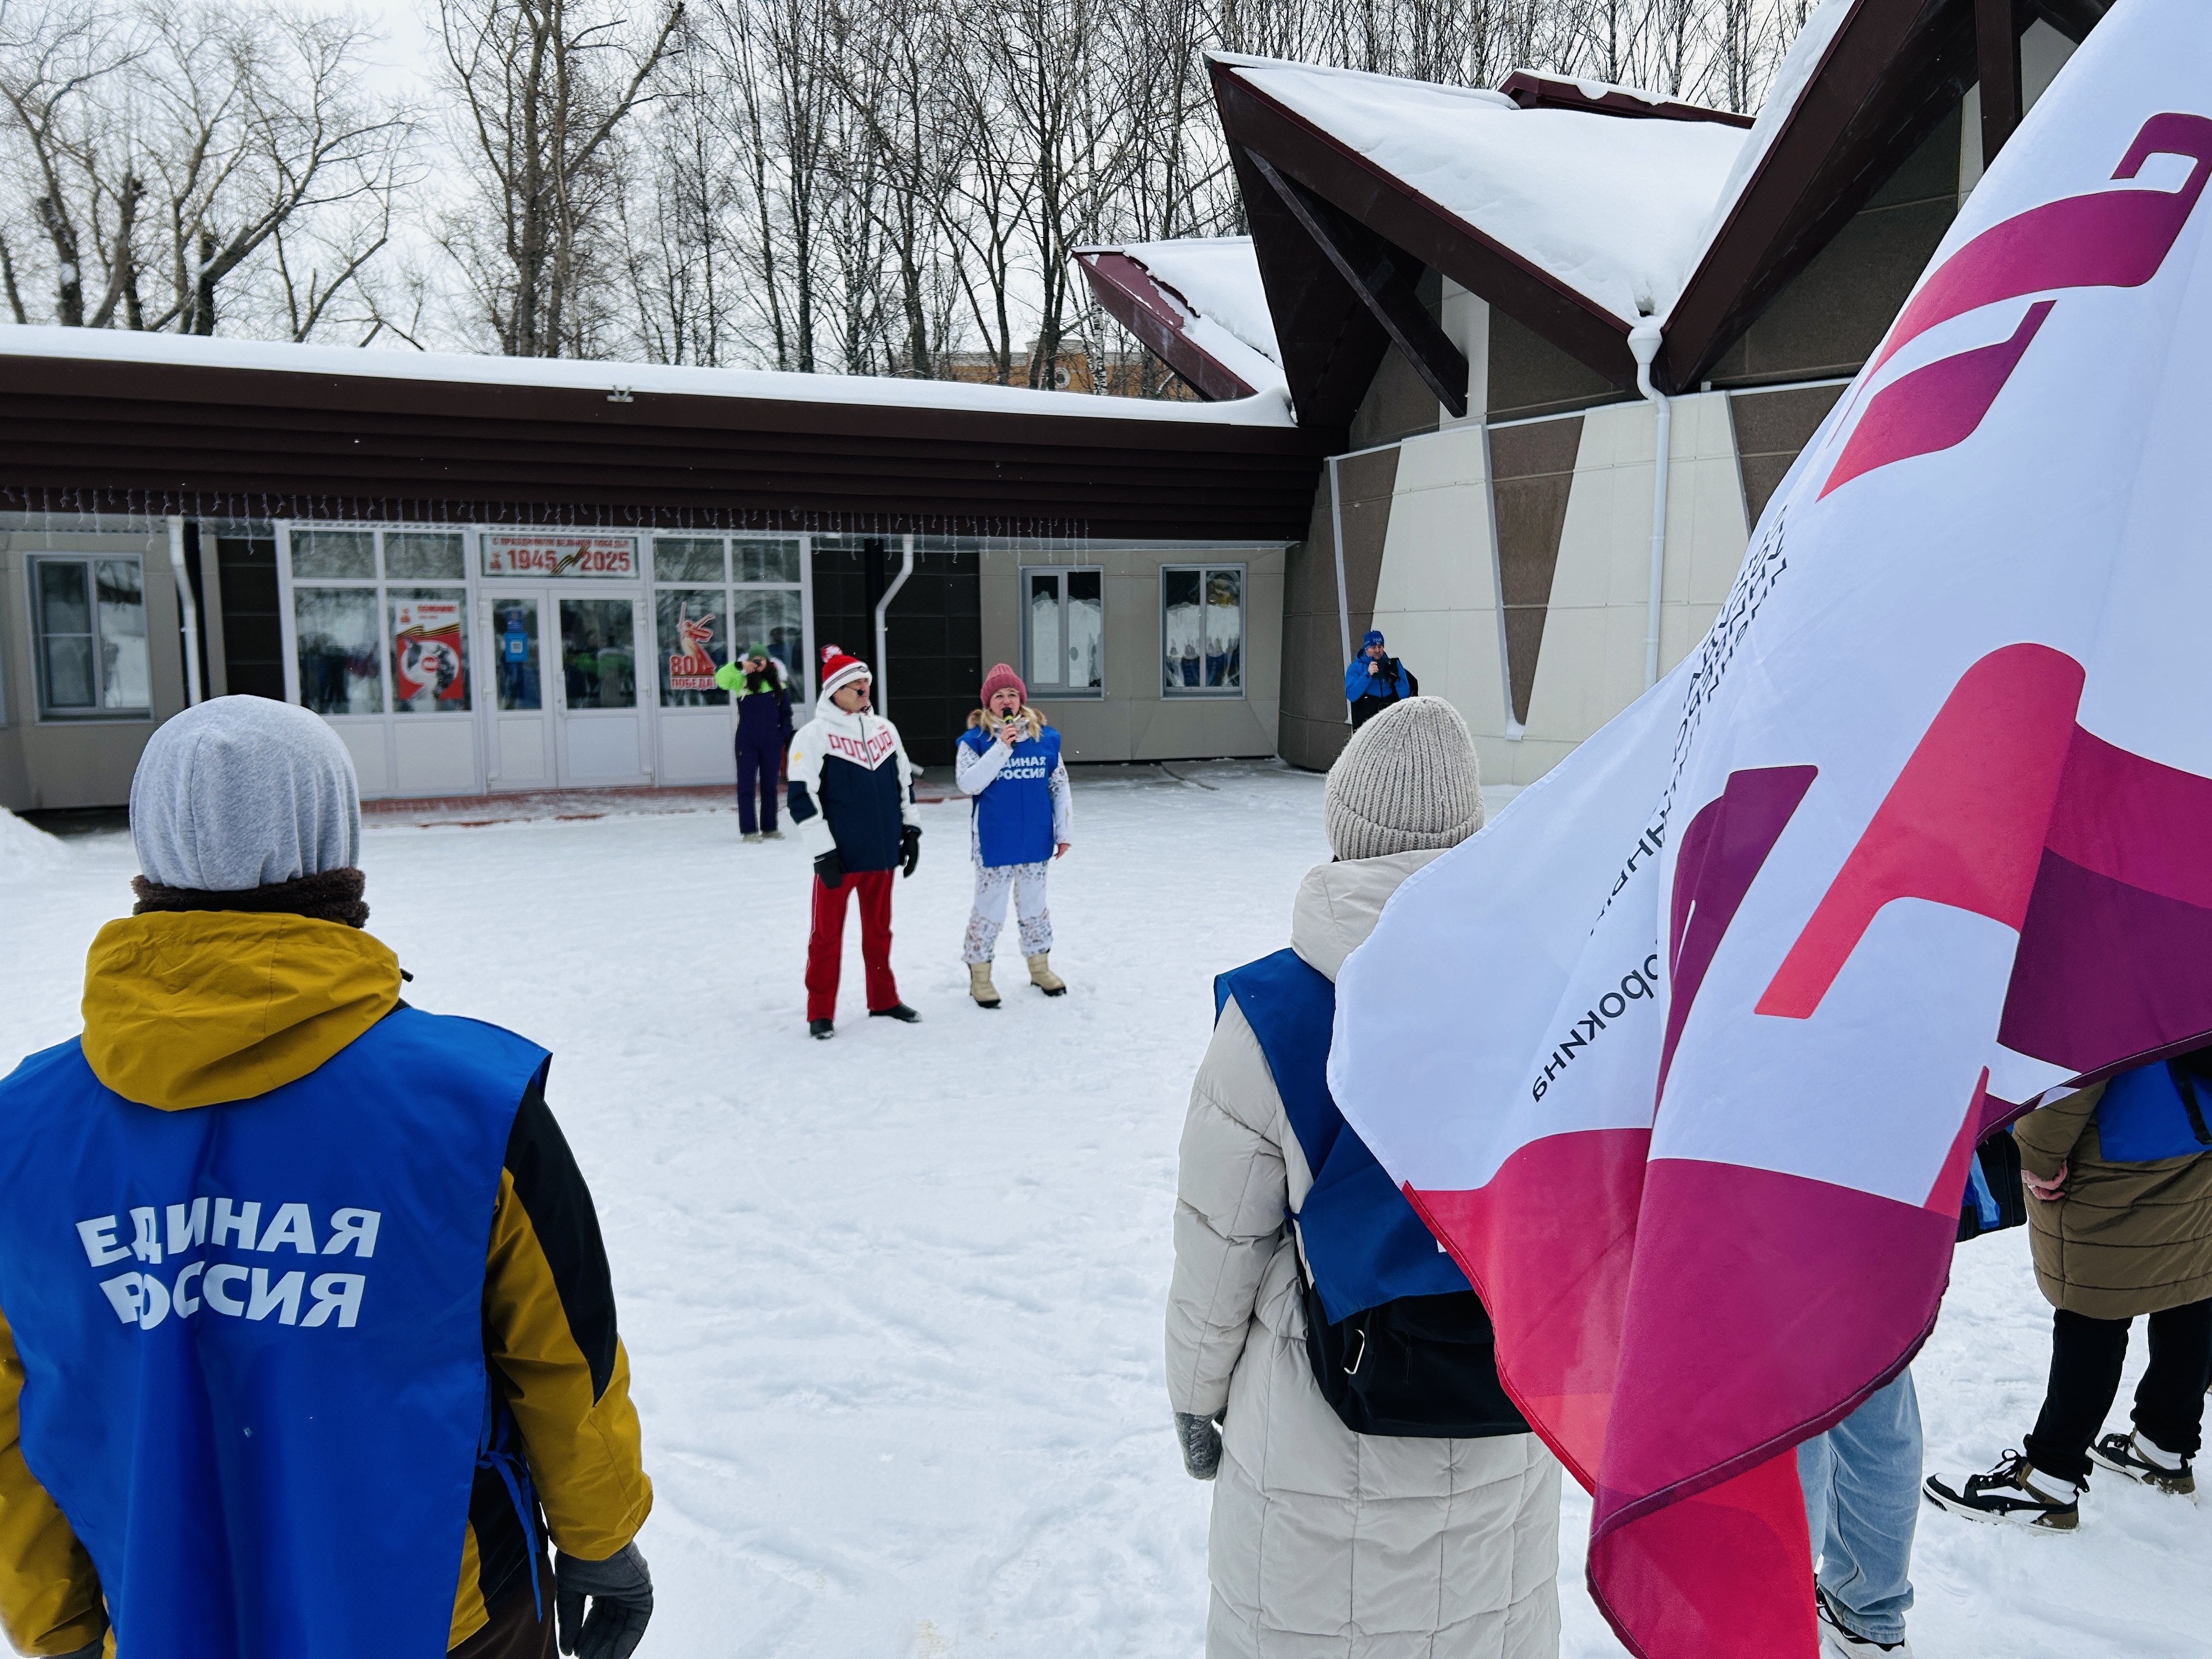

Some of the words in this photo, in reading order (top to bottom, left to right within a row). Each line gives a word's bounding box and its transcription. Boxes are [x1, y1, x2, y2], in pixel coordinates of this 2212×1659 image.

[506, 549, 557, 571] 1945
[581, 550, 630, 571] 2025
[671, 656, 693, 675] 80
[1005, 755, 1047, 769] ДИНАЯ
[76, 1197, 381, 1268] ЕДИНАЯ
[99, 1261, 366, 1331] РОССИЯ
